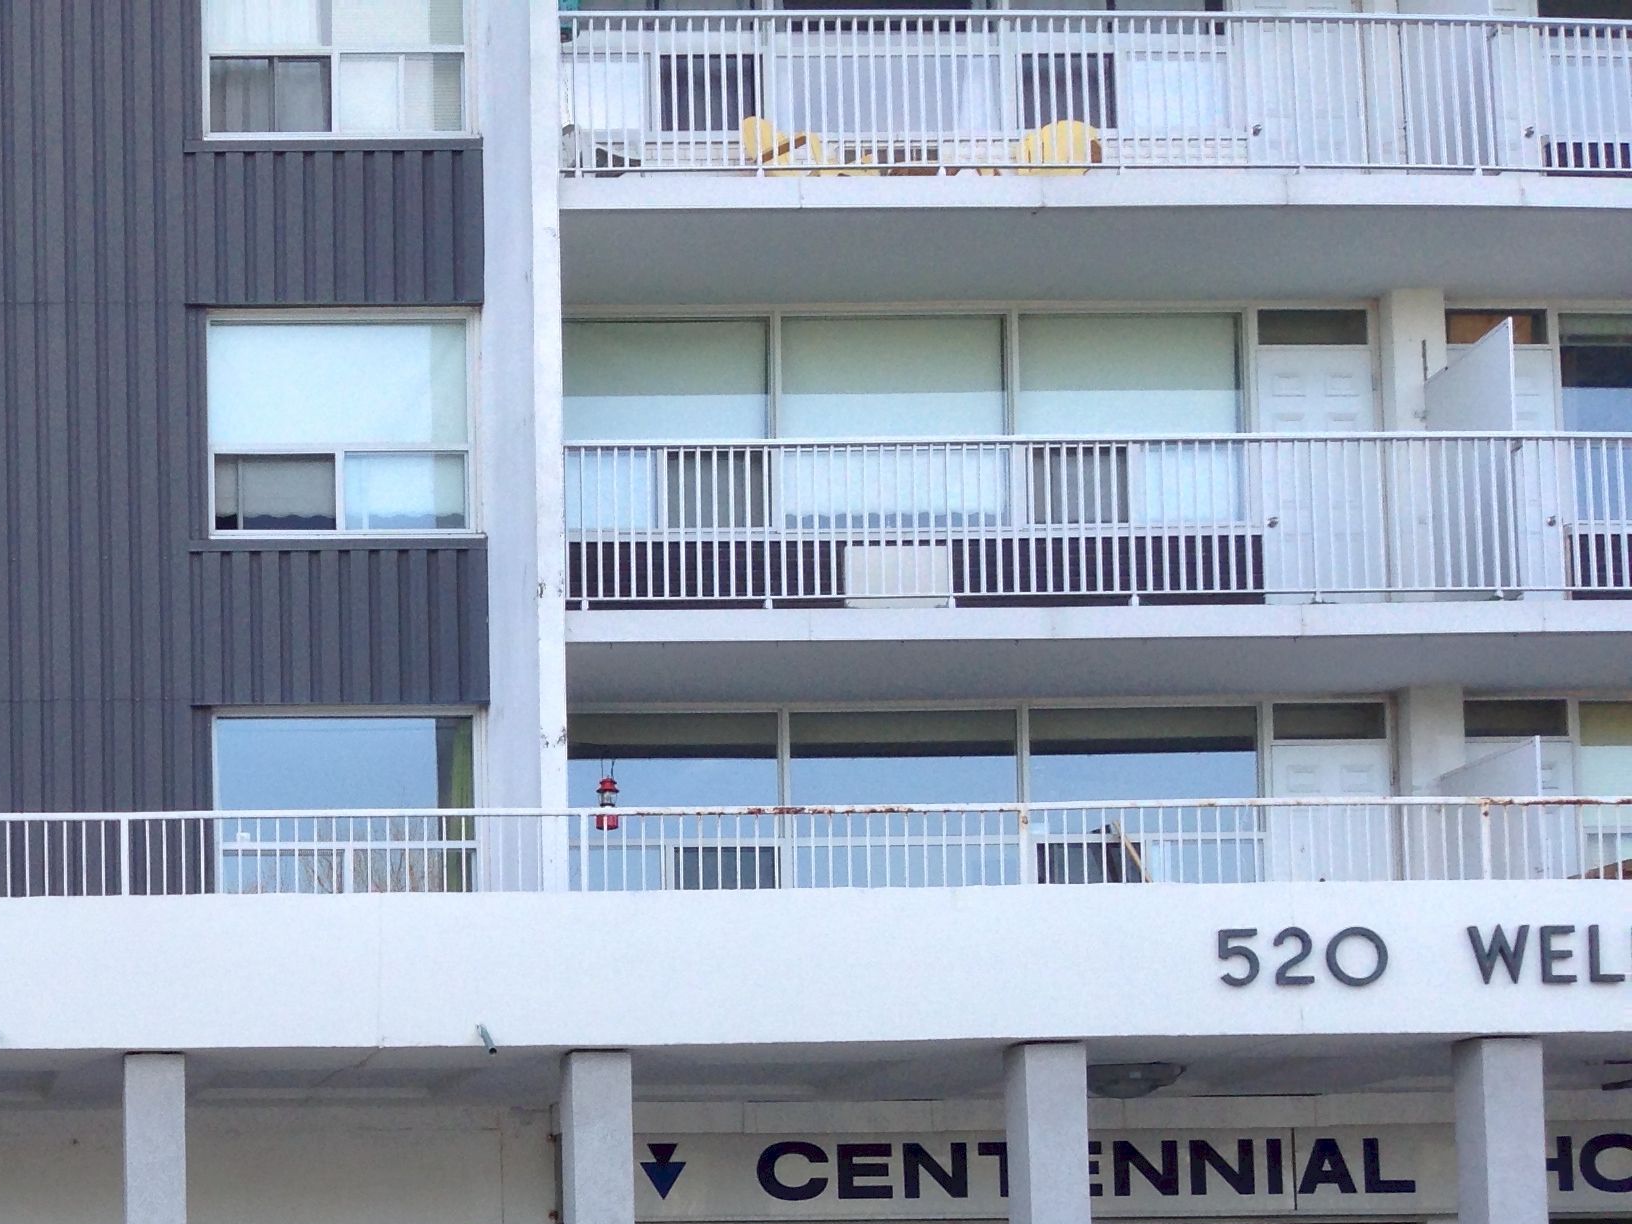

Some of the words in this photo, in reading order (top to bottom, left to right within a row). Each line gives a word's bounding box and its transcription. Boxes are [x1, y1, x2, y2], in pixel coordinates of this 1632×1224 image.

[1217, 926, 1389, 987] 520
[1466, 923, 1632, 985] WEL
[757, 1137, 1417, 1201] CENTNNIAL
